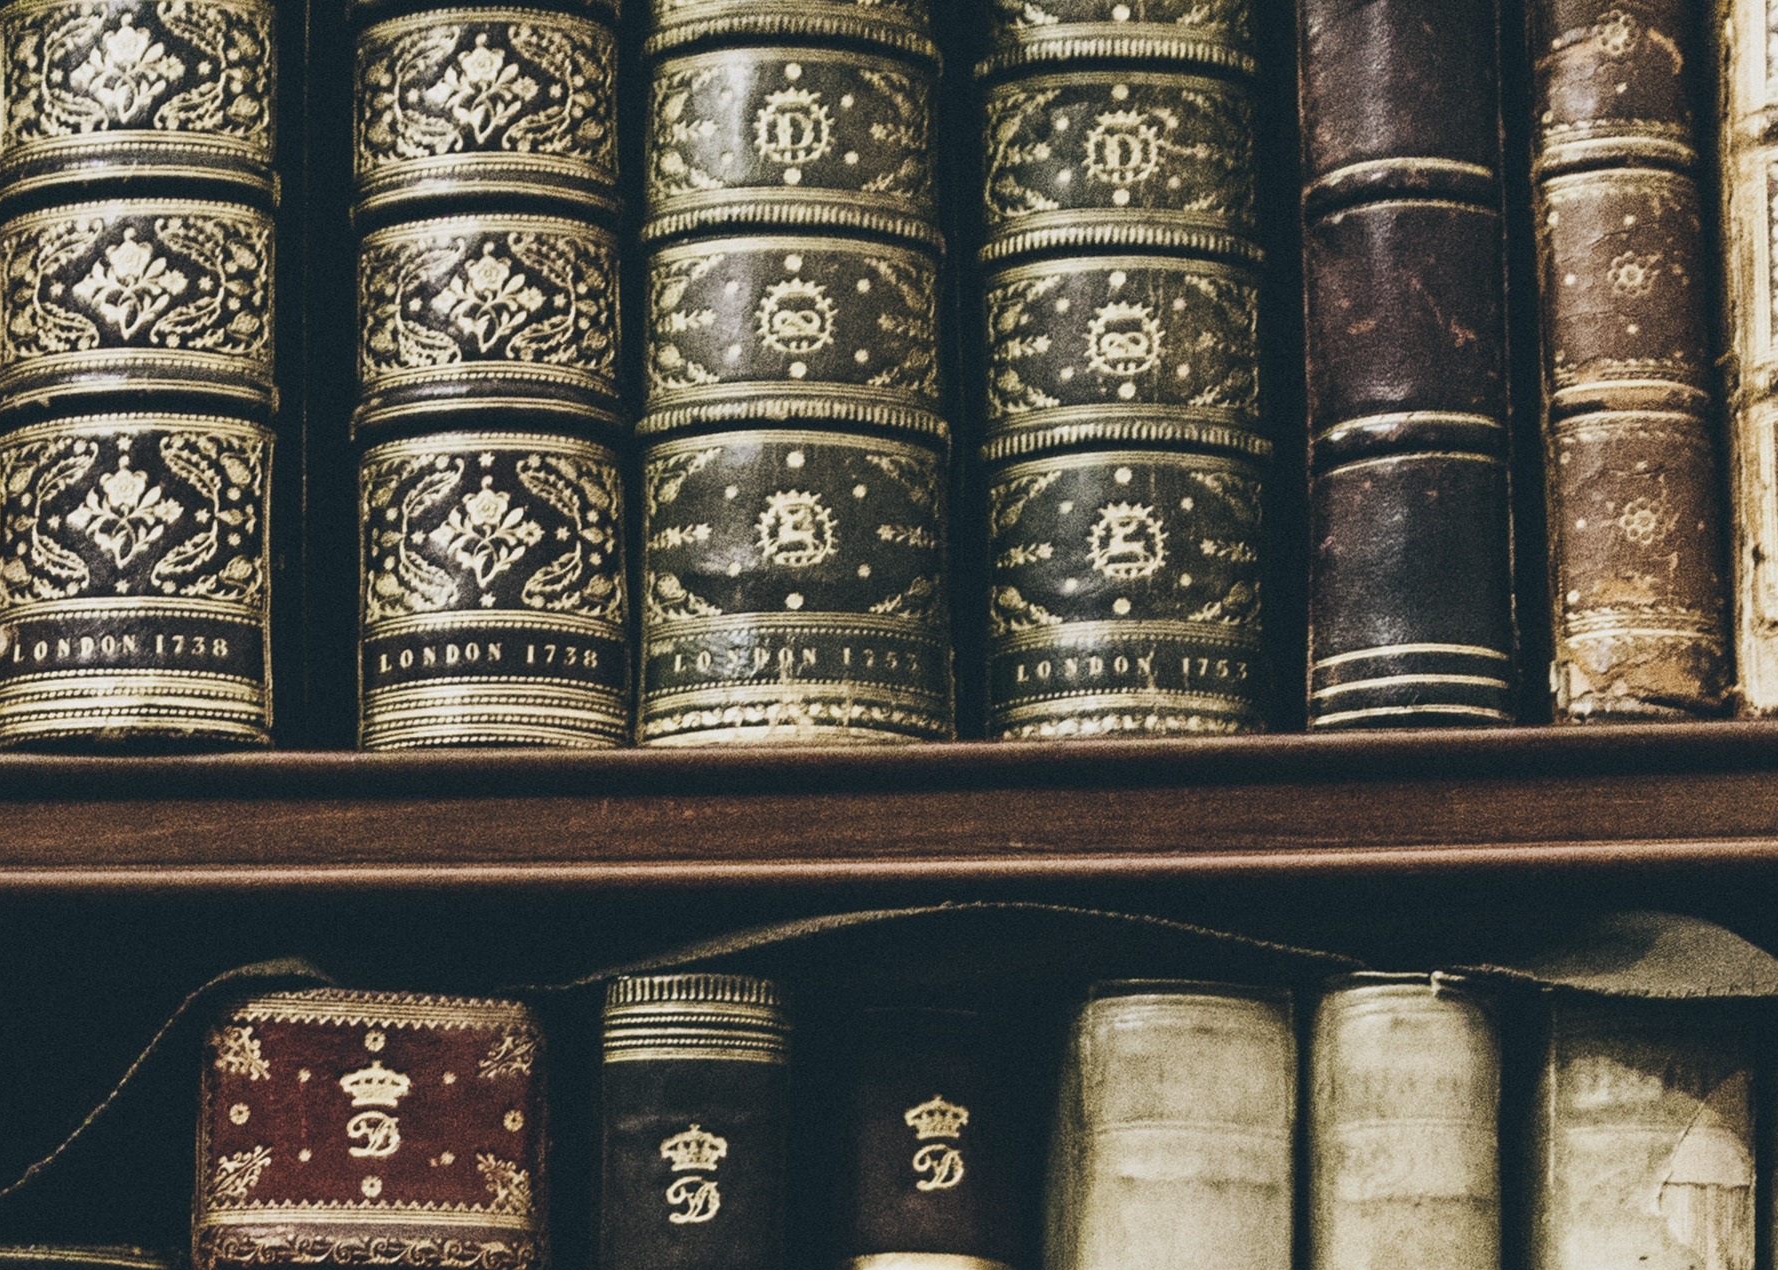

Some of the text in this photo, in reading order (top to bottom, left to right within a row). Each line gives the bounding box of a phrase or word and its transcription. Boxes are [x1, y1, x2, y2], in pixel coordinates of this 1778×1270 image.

[13, 634, 228, 662] LONDON 1738
[379, 643, 598, 672] LONDON 1738
[674, 647, 816, 673] LONDON
[1017, 656, 1248, 682] LONDON 1753
